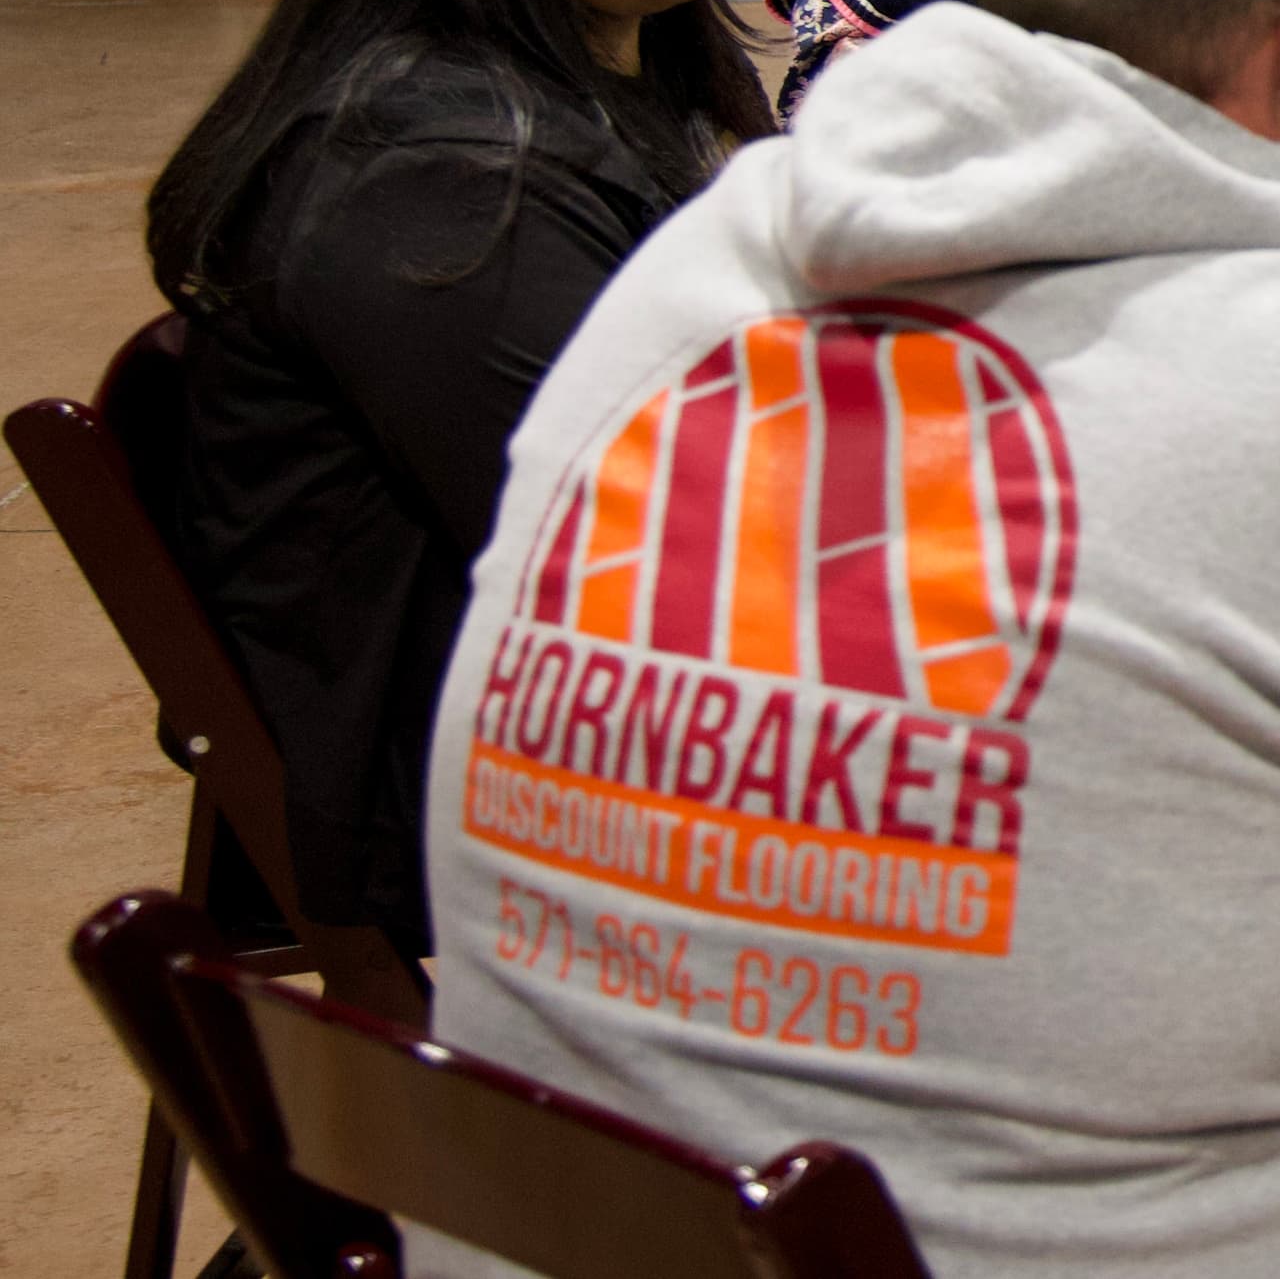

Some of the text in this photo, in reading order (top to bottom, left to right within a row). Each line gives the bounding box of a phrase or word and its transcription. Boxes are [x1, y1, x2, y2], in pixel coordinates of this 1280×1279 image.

[477, 627, 1031, 855] HORNBAKER
[475, 761, 990, 939] DISCOUNT FLOORING
